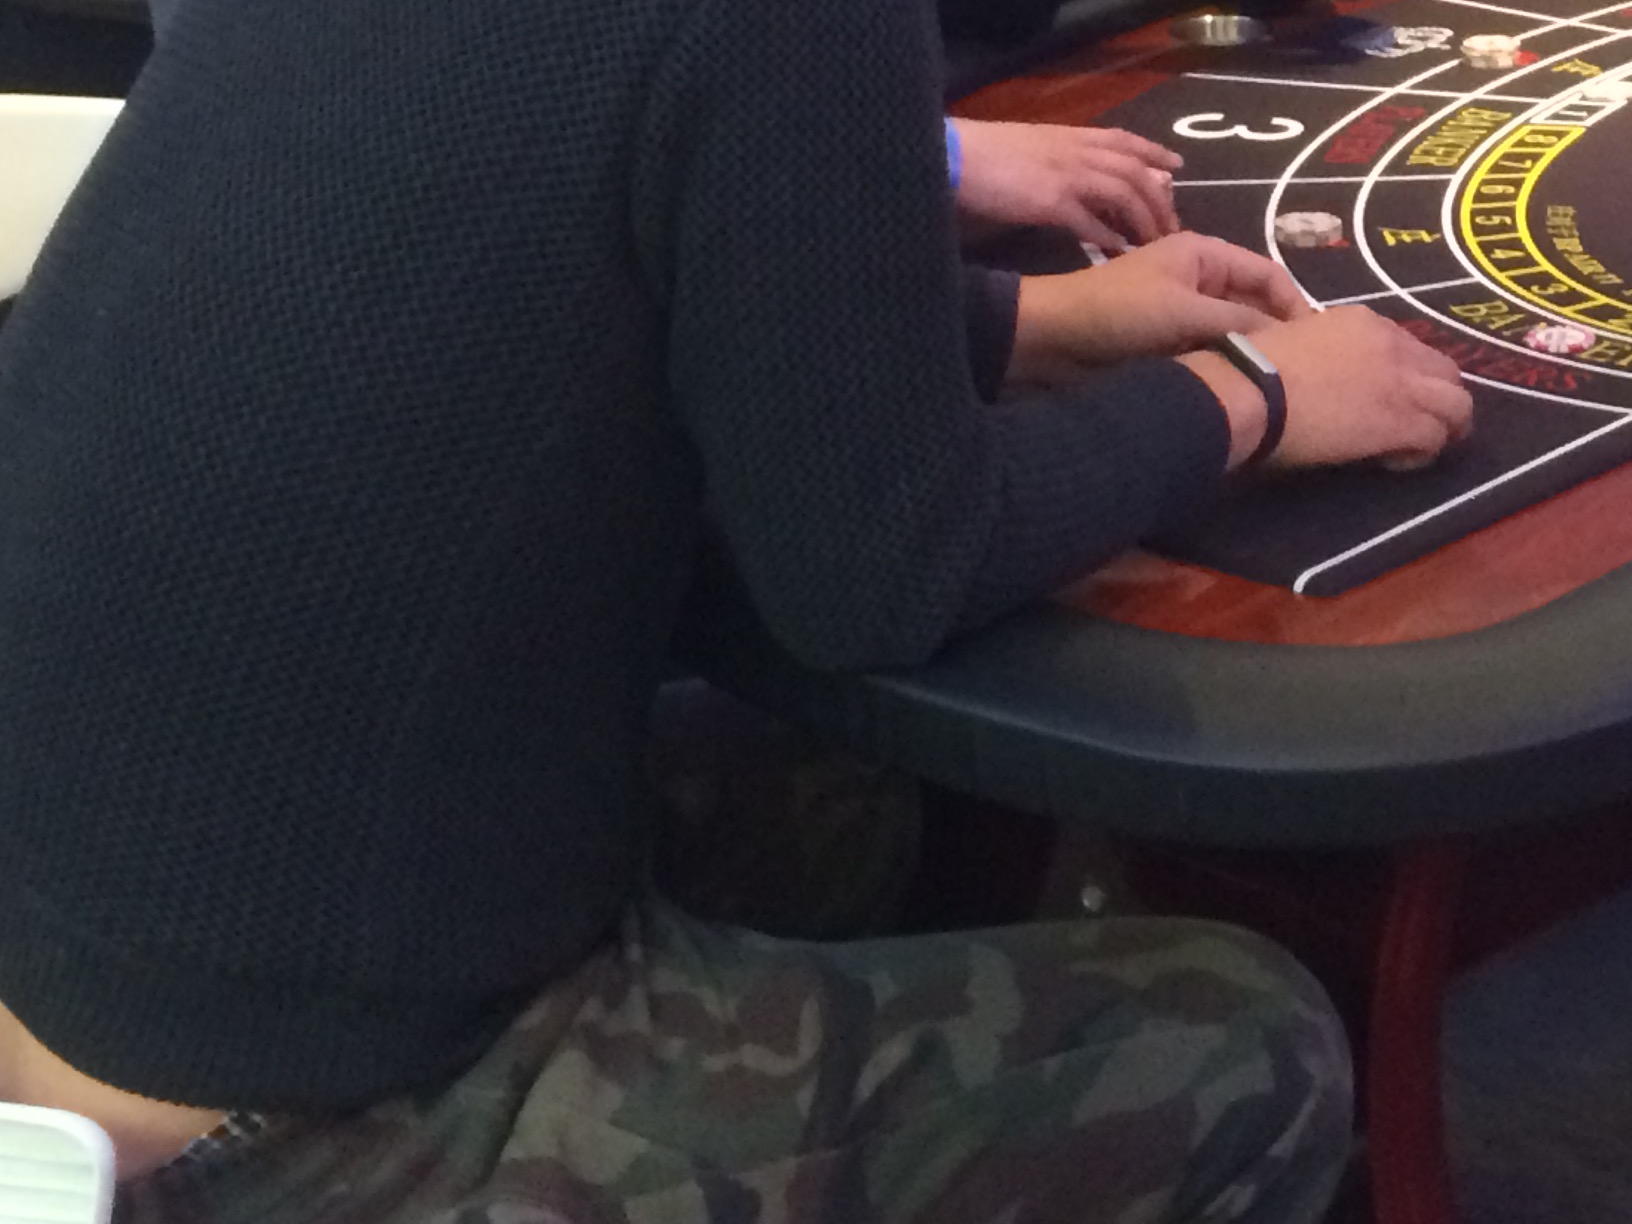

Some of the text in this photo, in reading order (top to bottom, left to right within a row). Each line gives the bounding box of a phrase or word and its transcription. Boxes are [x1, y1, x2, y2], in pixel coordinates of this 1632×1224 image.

[1173, 114, 1304, 141] 3
[1406, 107, 1513, 167] BANKER
[1523, 134, 1560, 146] 8
[1497, 158, 1533, 170] 7
[1478, 184, 1516, 197] 6
[1474, 215, 1514, 227] 5
[1489, 248, 1524, 261] 4
[1529, 282, 1570, 297] 3
